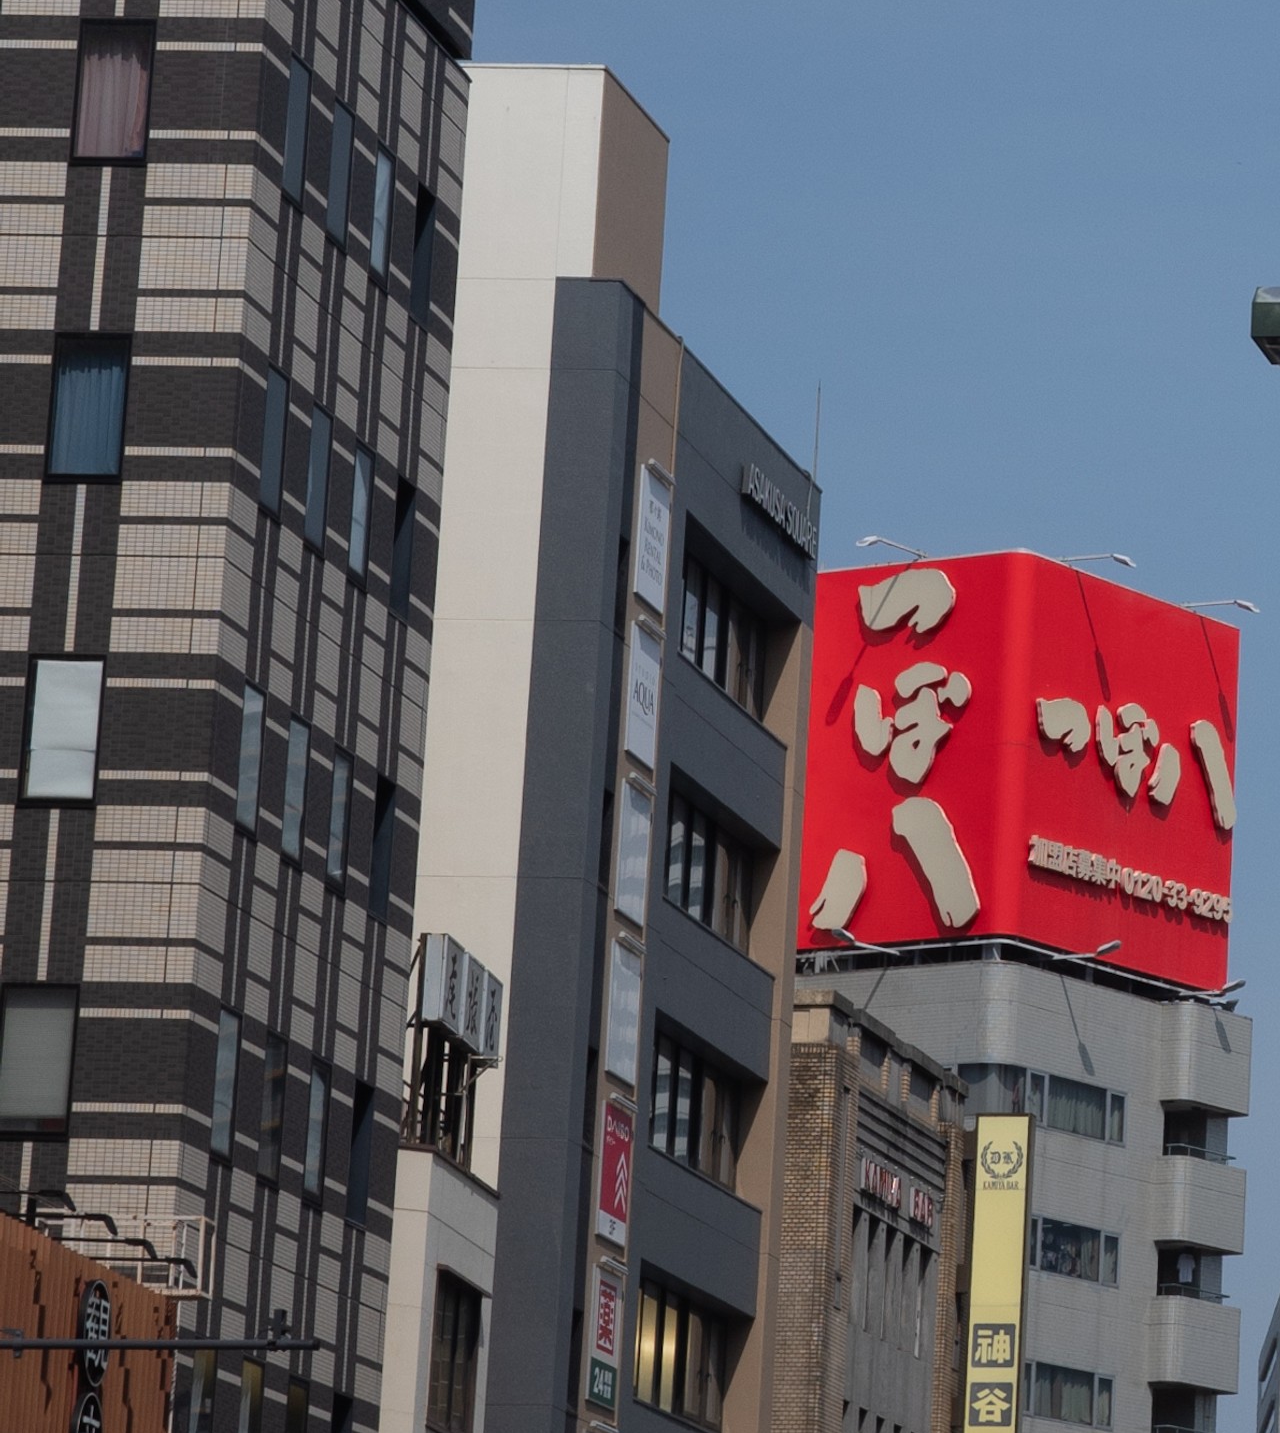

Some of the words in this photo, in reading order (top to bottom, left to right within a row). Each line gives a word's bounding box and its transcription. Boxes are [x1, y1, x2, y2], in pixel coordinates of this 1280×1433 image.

[749, 463, 785, 529] ASAKUSA
[786, 501, 816, 560] SQUARE
[633, 679, 654, 715] AQUA
[808, 568, 980, 929] つぼ八
[1036, 698, 1236, 831] つぼ八
[1121, 867, 1232, 923] 0120-33-9295
[600, 1287, 616, 1349] 薬
